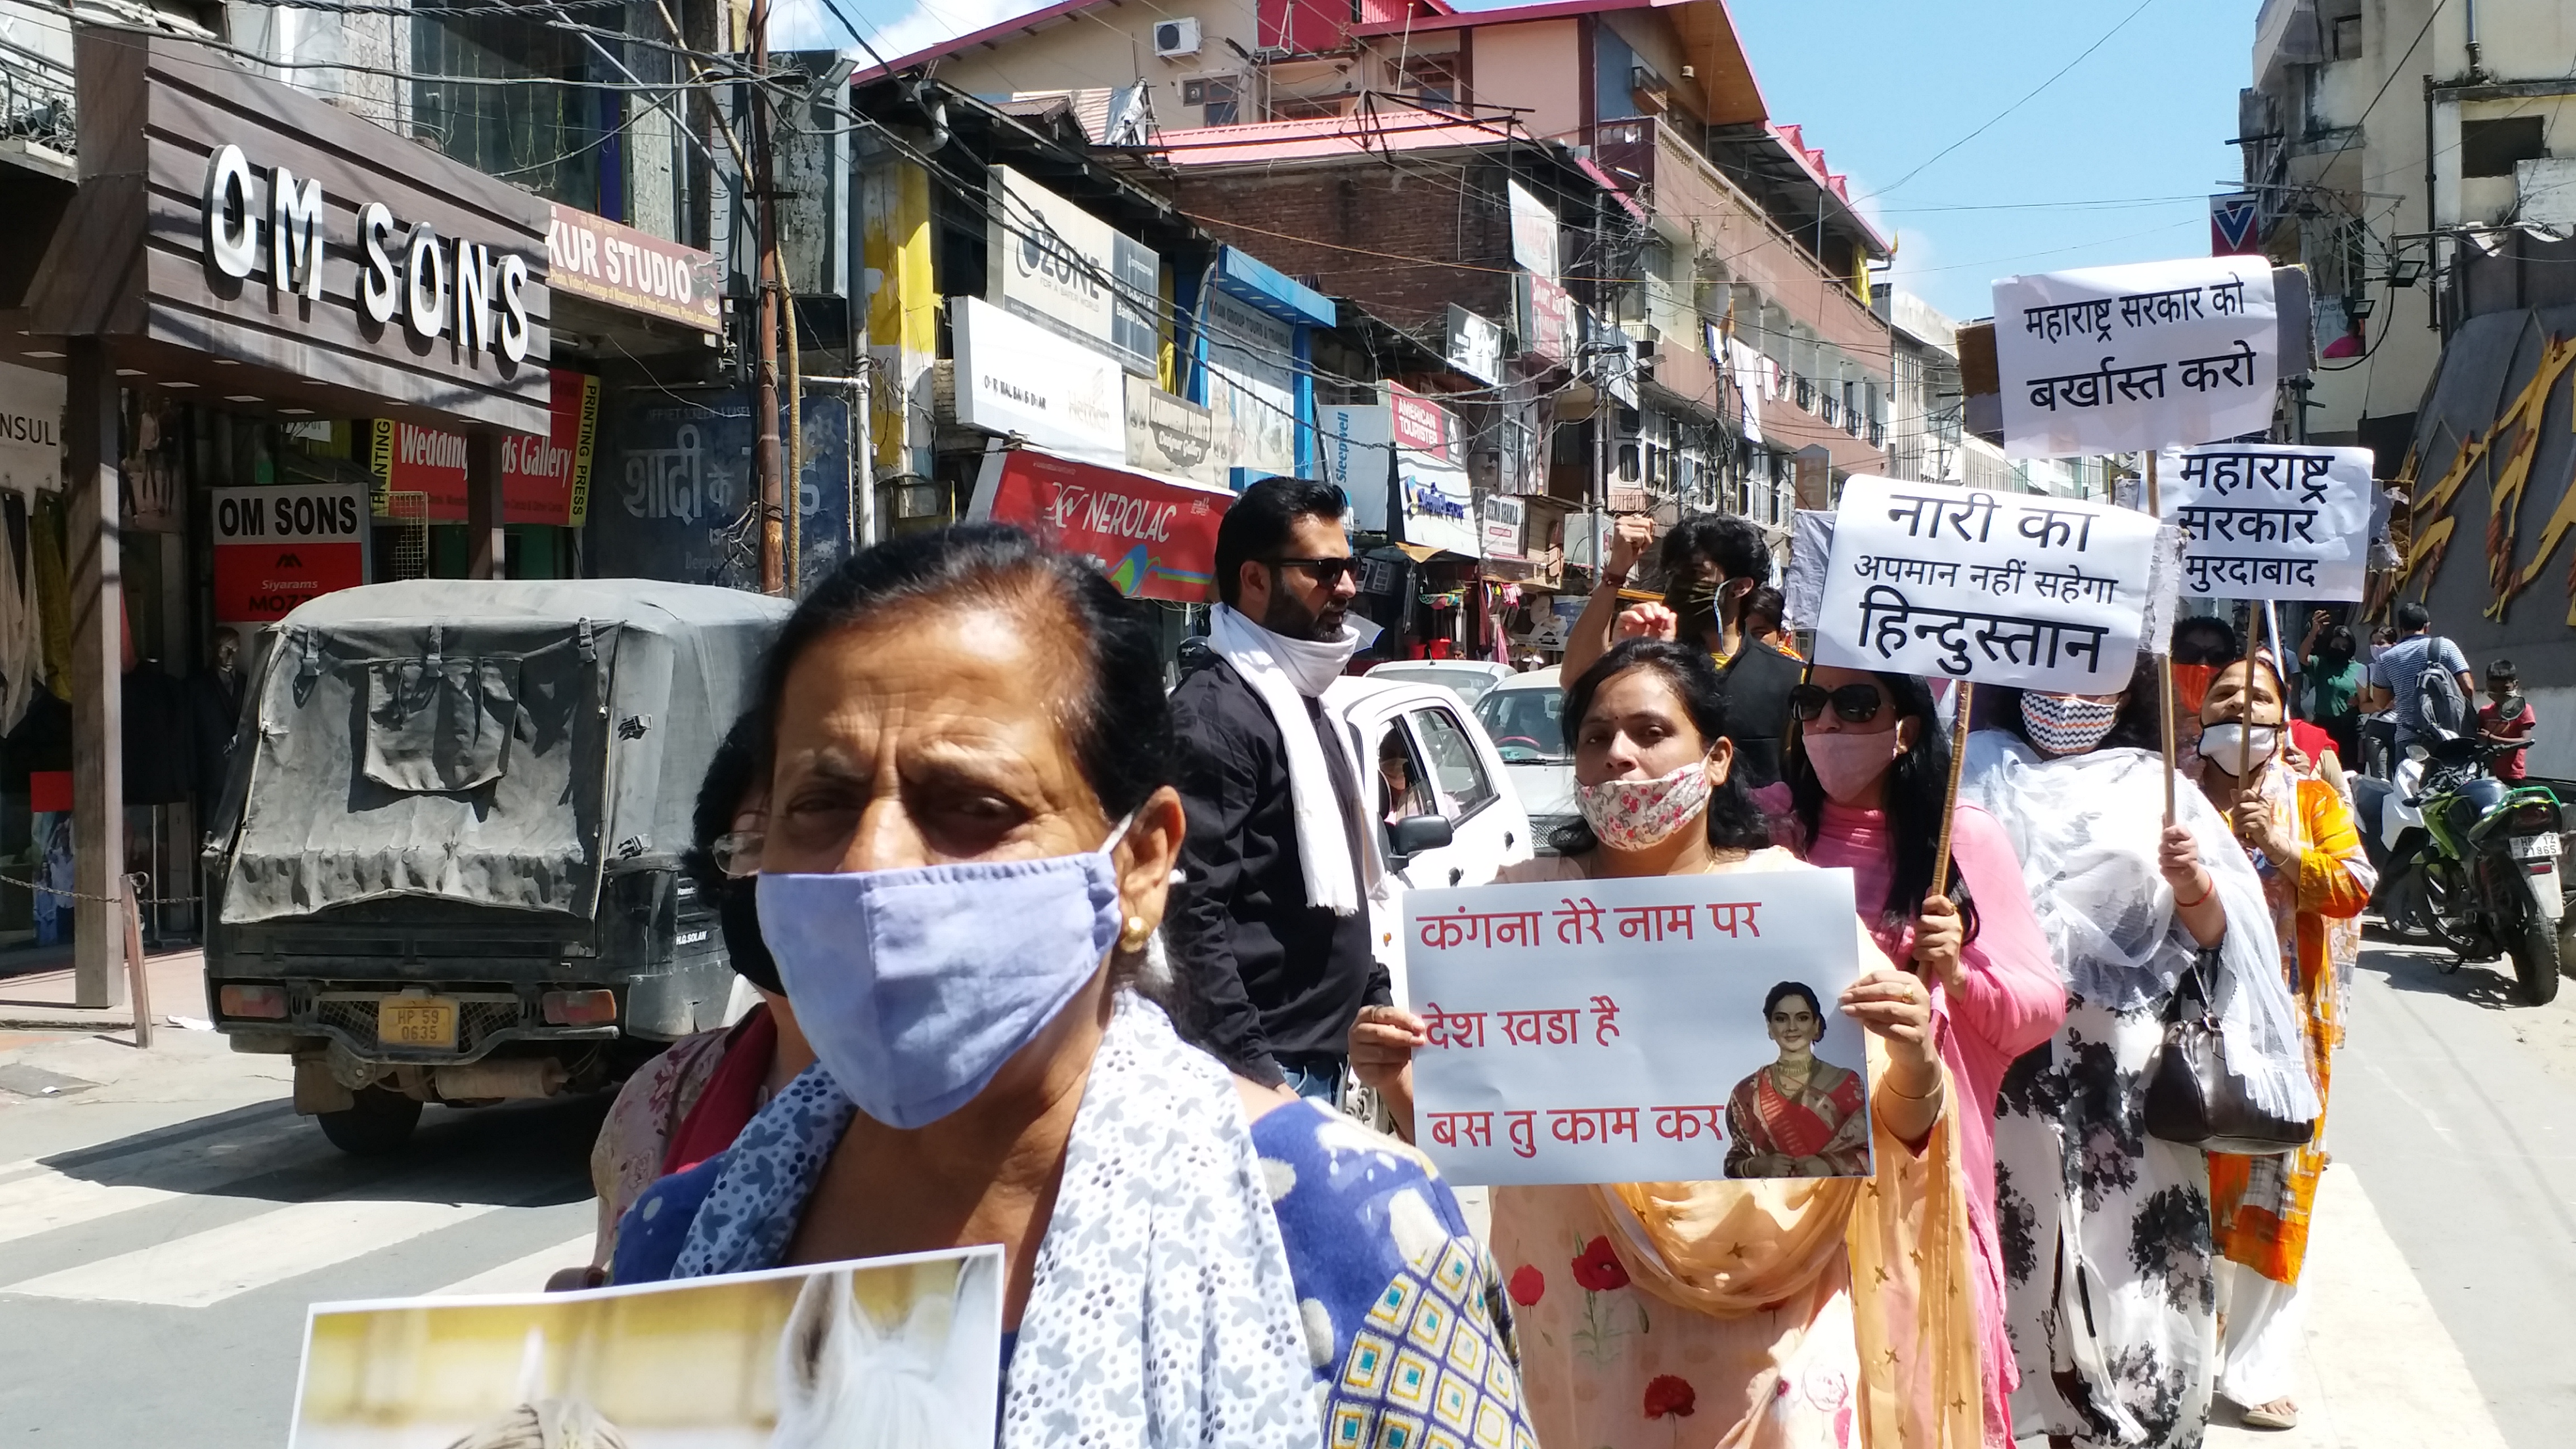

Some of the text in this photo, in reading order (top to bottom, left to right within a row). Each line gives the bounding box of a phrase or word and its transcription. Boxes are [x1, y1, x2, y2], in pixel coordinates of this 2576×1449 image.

[202, 144, 528, 363] OM SONS
[604, 236, 692, 305] STUDIO
[2024, 272, 2245, 343] महाराष्ट्र सरकार को
[2027, 340, 2256, 412] बर्खास्त करो
[0, 413, 57, 447] NSUL
[579, 385, 596, 458] PRINTING
[1398, 397, 1436, 430] AMERICAN
[1399, 415, 1438, 446] TOURISTER
[520, 435, 572, 489] Gallery
[1335, 411, 1349, 483] Sleepwell
[572, 465, 588, 515] PRESS
[621, 424, 703, 526] शादी
[2180, 453, 2335, 504] महाराष्ट्र
[218, 496, 357, 537] OM SONS
[1081, 490, 1177, 543] NEROLAC
[1888, 493, 2100, 552] नारी का
[2177, 506, 2319, 544] सरकार
[261, 579, 319, 591] Siyarams
[1854, 555, 2119, 604] अपमान नहीं सहेगा
[2185, 555, 2319, 593] मुरदाबाद
[1858, 585, 2110, 675] हिन्दुस्तान
[1416, 897, 1763, 950] कंगना तेरे नाम पर
[397, 1009, 439, 1025] HP 59
[401, 1025, 438, 1040] 0635
[1421, 1002, 1488, 1049] देश
[1589, 995, 1620, 1047] है
[1427, 1105, 1725, 1158] बस तु काम कर
